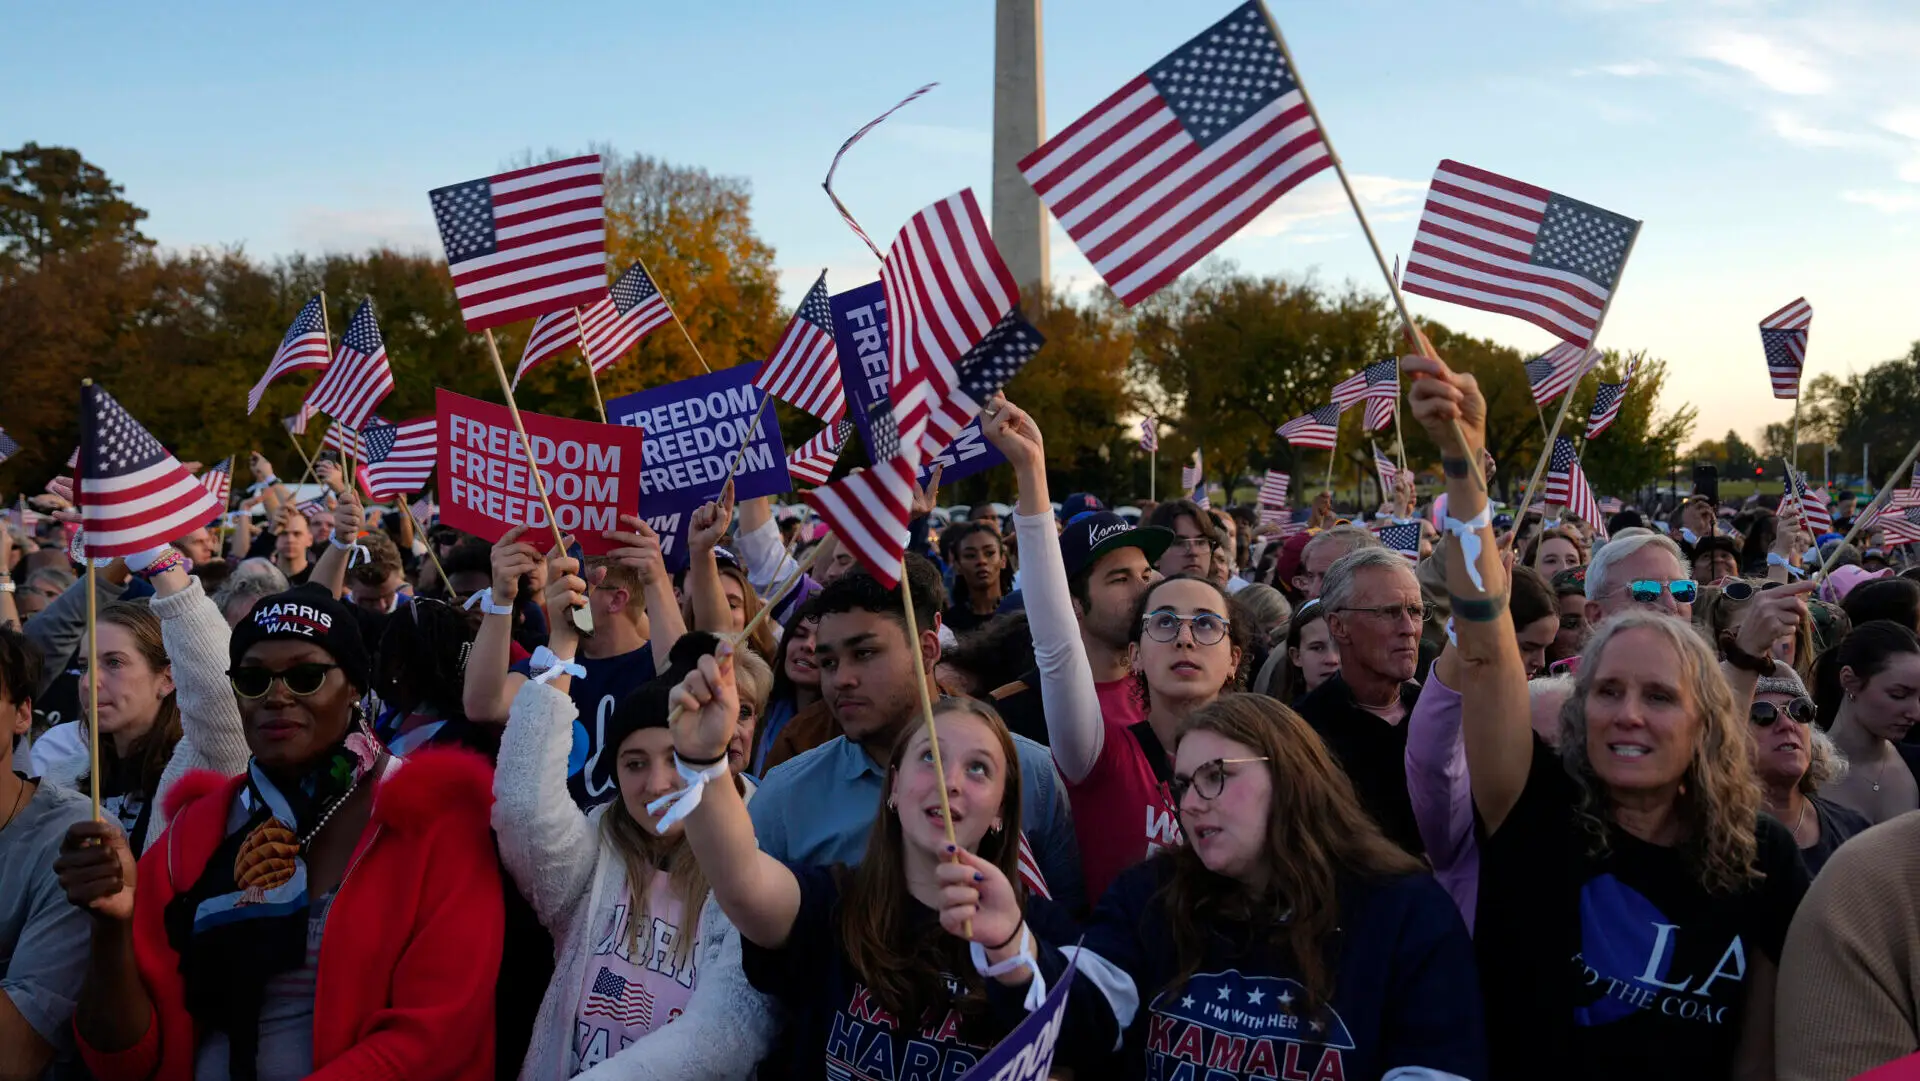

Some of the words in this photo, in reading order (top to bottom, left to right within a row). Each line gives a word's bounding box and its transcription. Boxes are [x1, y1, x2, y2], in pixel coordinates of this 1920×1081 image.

[449, 413, 621, 473] FREEDOM
[640, 413, 766, 467] REEDOM
[449, 445, 620, 503] FREEDOM
[639, 442, 776, 496] FREEDOM
[450, 476, 618, 531] FREEDOM
[254, 603, 332, 628] HARRIS
[266, 621, 314, 637] WALZ
[1203, 1002, 1229, 1022] I'M
[1231, 1009, 1265, 1029] WITH
[1267, 1014, 1299, 1030] HER
[1604, 976, 1657, 1010] THE
[1661, 996, 1728, 1024] COAC
[1148, 1014, 1346, 1081] KAMALA
